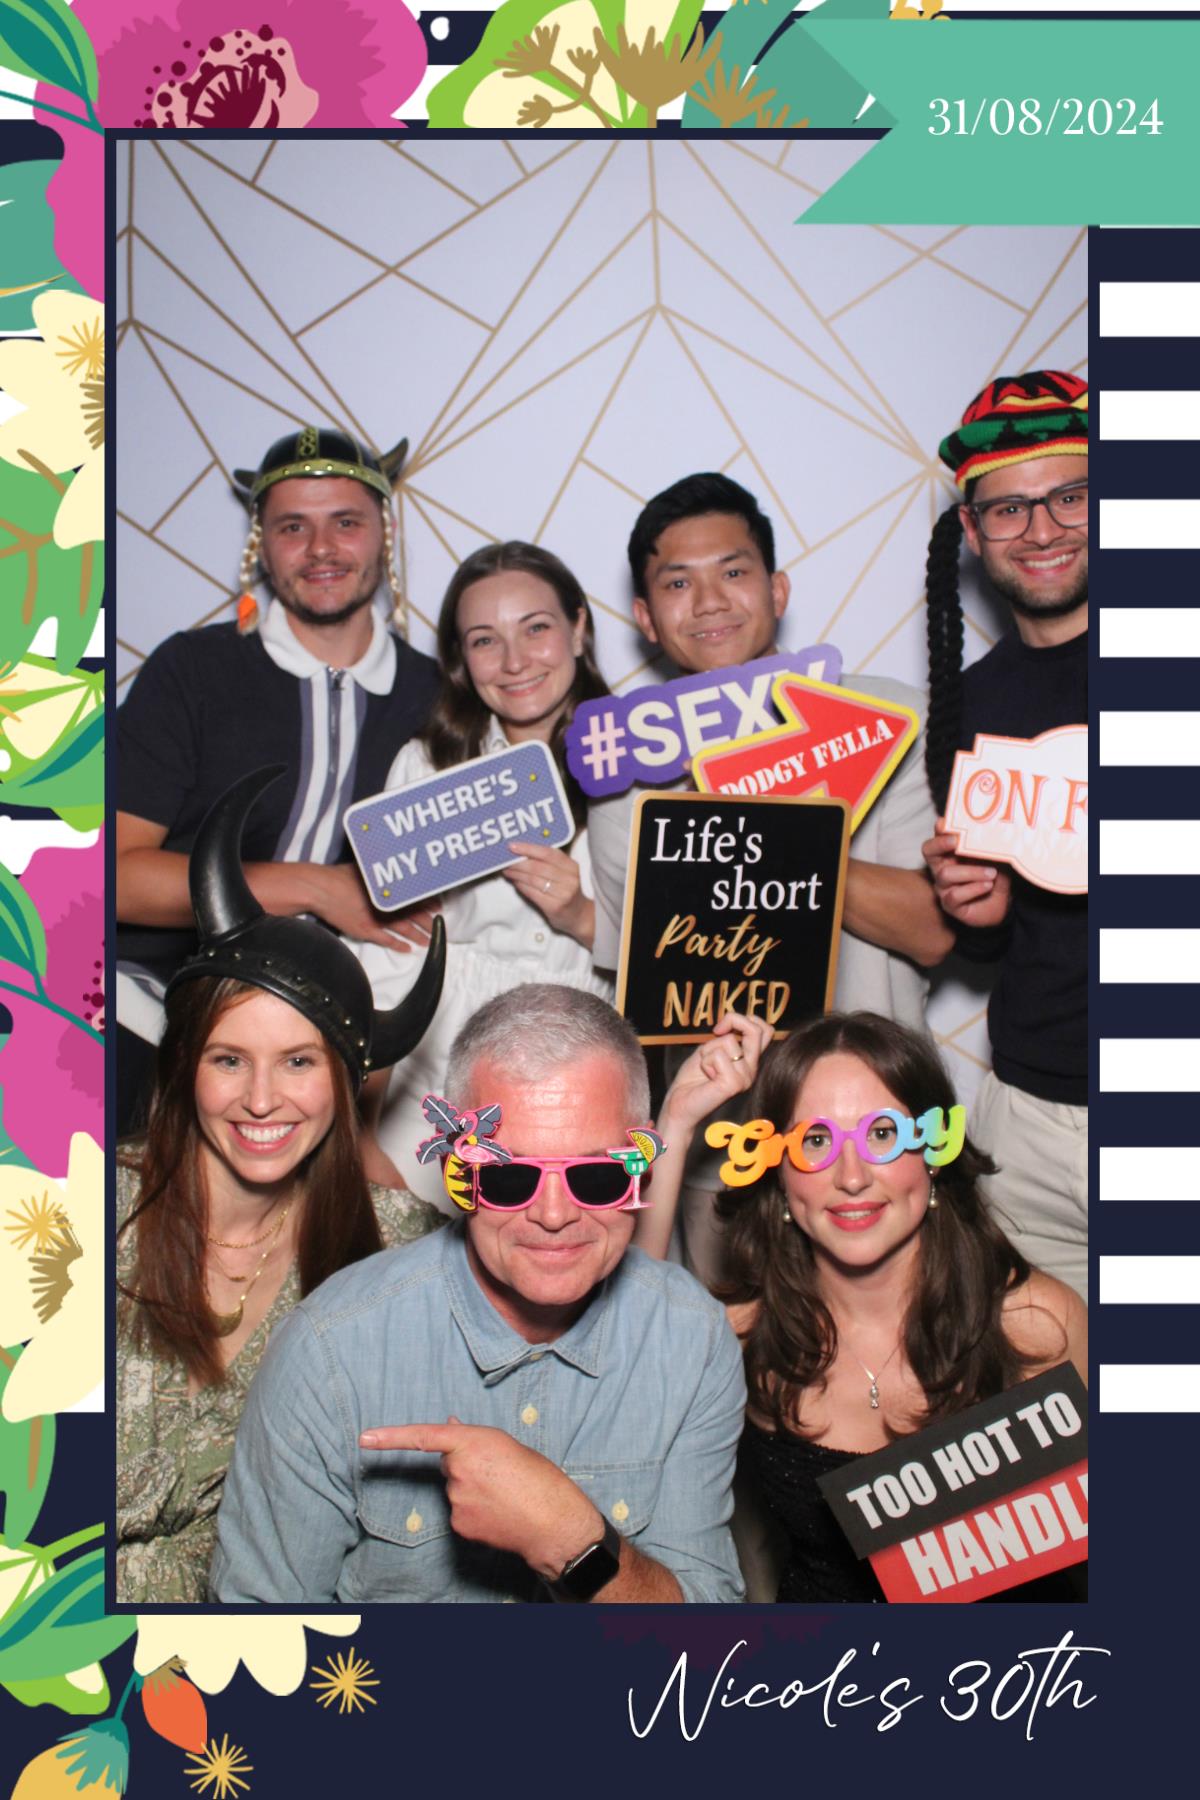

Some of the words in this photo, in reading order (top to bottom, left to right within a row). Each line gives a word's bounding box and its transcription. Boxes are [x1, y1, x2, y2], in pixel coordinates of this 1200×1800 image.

[811, 718, 894, 768] FELLA
[383, 768, 519, 838] WHERE'S
[962, 768, 1049, 829] ON
[371, 847, 419, 888] MY
[424, 796, 555, 867] PRESENT
[650, 815, 763, 864] Life's
[710, 864, 823, 911] short
[654, 913, 782, 977] Party
[663, 979, 791, 1028] NAKED
[845, 1461, 938, 1530] TOO
[931, 1416, 1022, 1492] HOT
[1015, 1391, 1083, 1449] TO
[900, 1473, 1088, 1596] HANDL
